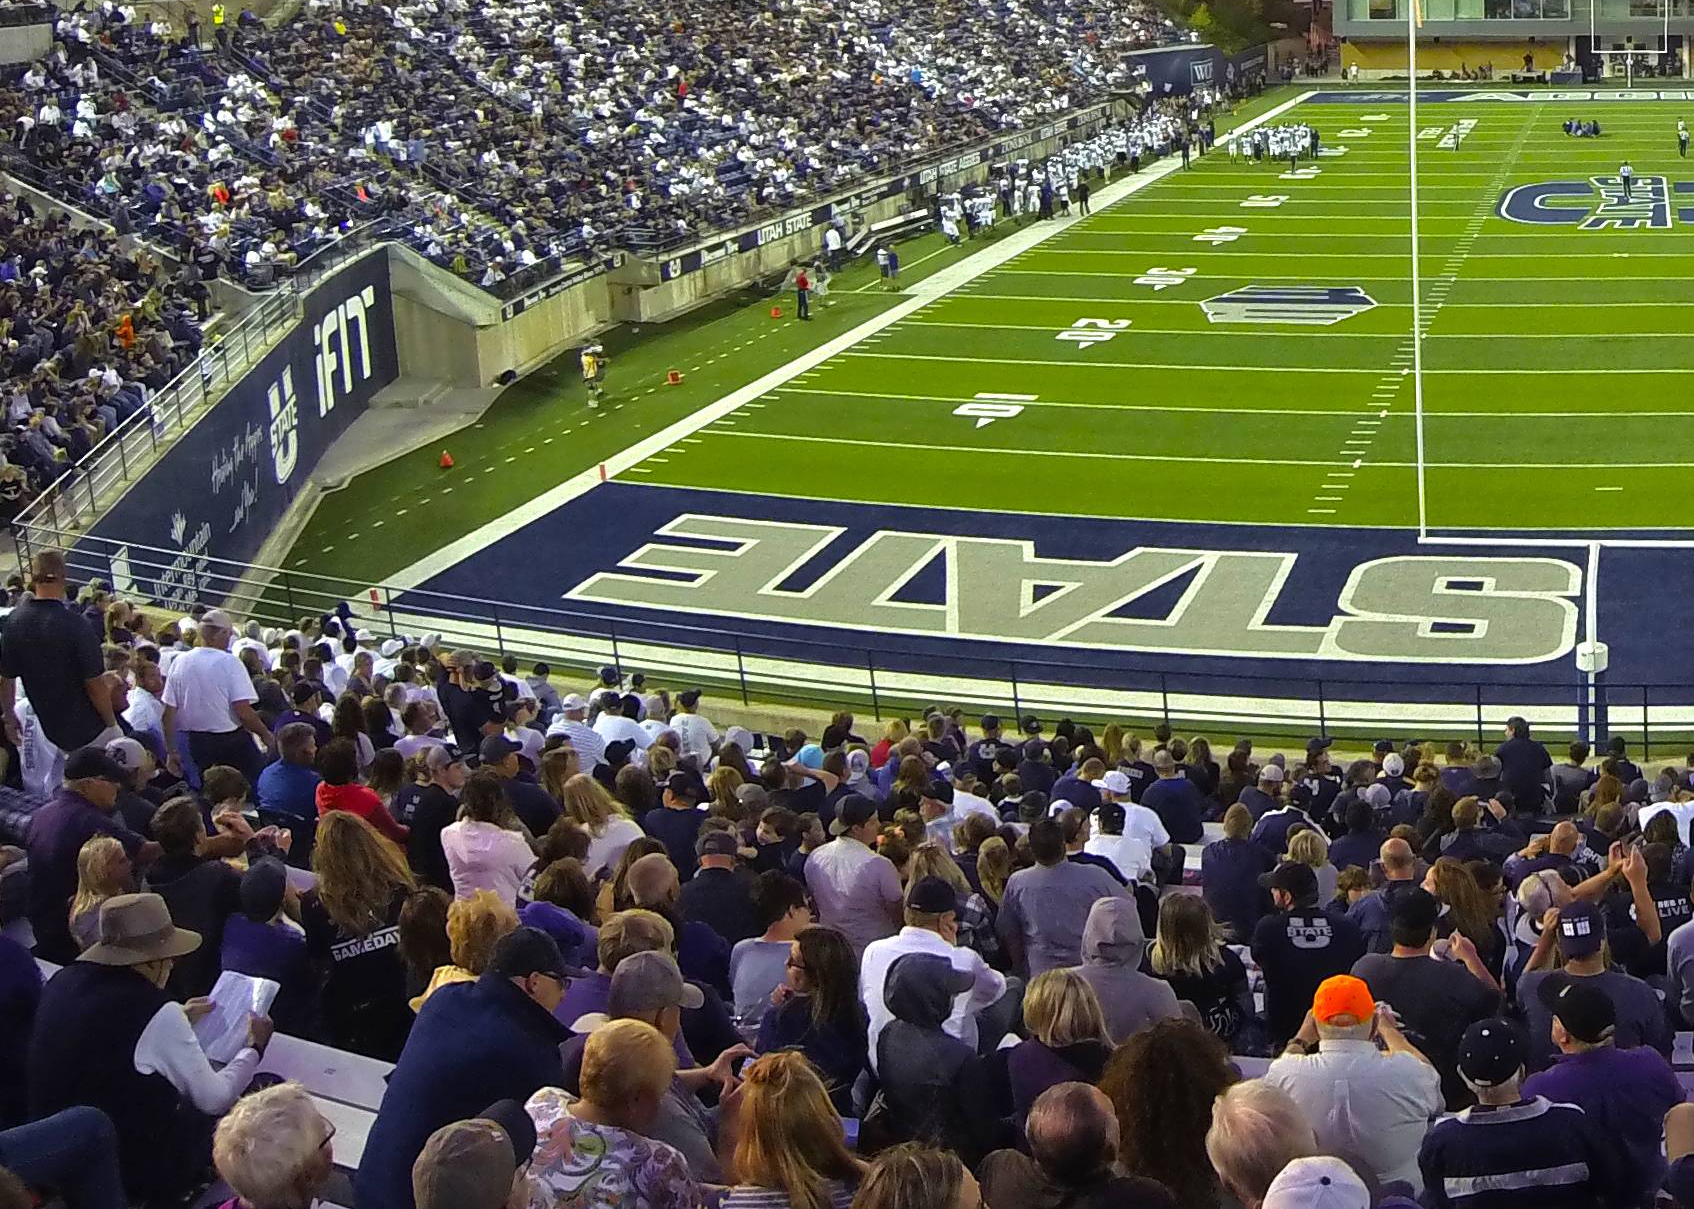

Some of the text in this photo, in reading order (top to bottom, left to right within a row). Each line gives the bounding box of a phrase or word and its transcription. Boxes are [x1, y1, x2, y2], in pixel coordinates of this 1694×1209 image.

[758, 212, 813, 246] UTAH STATE
[1054, 317, 1133, 345] 20
[314, 285, 375, 418] iFIT
[952, 392, 1039, 418] 10
[270, 394, 299, 459] STATE
[562, 513, 1583, 665] STATE
[1658, 905, 1690, 918] LIVE
[331, 931, 401, 962] GAMEDAY
[1286, 925, 1333, 938] STATE
